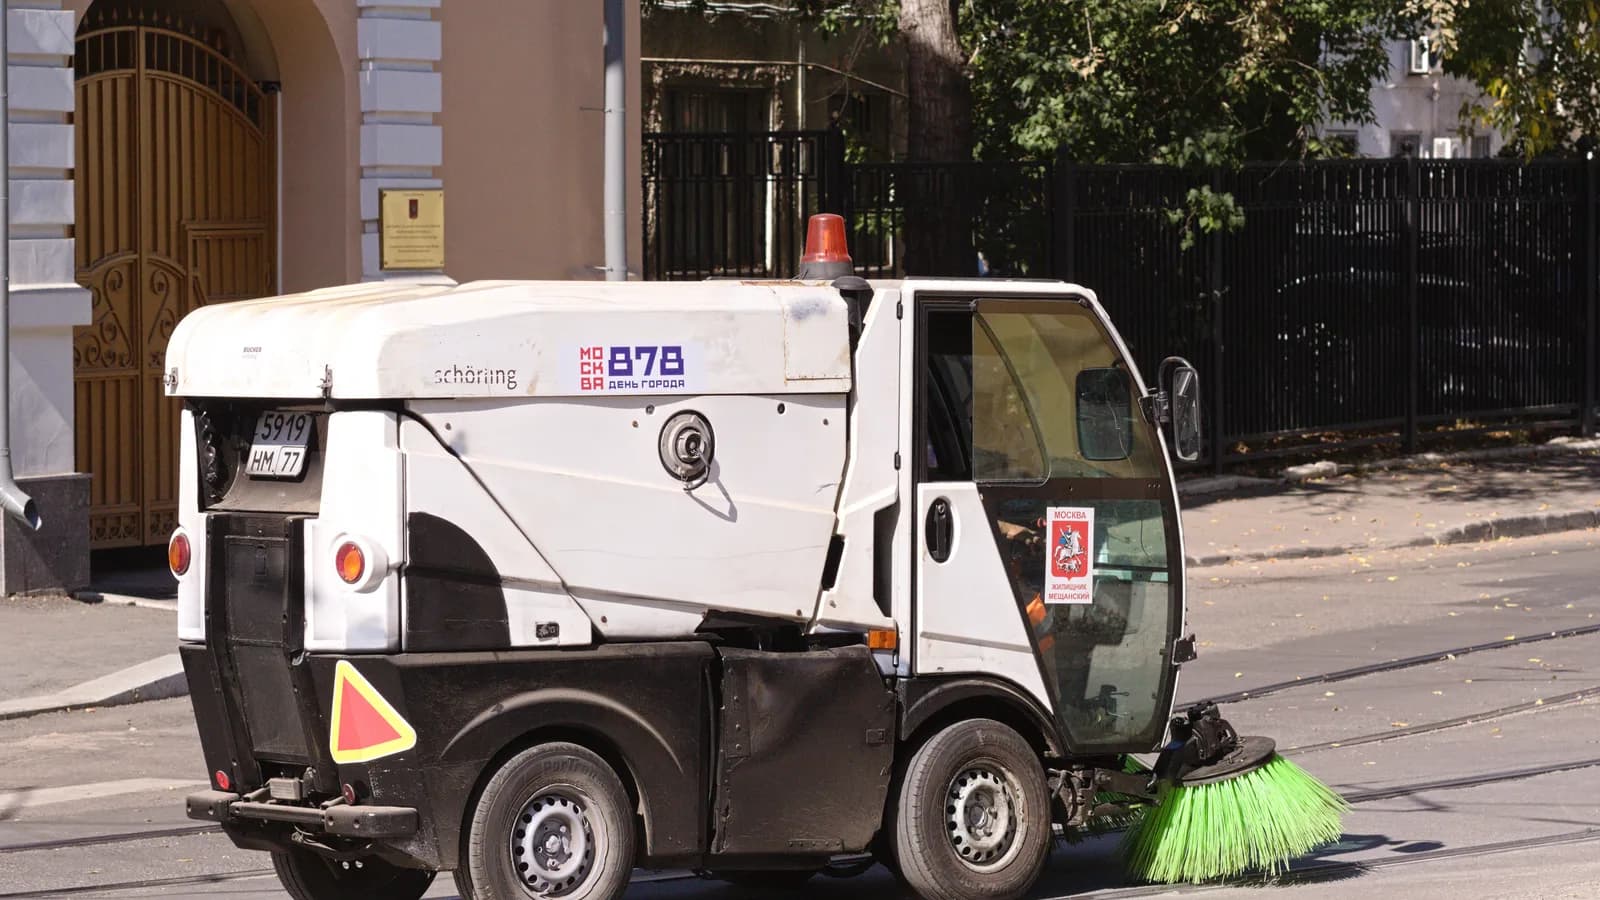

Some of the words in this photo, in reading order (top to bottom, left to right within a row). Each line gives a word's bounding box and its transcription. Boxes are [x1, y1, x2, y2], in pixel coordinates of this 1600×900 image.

[608, 345, 684, 376] 878
[608, 380, 638, 390] ДЕНЬ
[641, 379, 685, 389] ГОРОДА
[261, 413, 306, 441] 5919
[281, 451, 301, 473] 77
[1054, 511, 1087, 520] МОСКВА
[1051, 583, 1088, 591] ЖИЛИЩНИК
[1048, 591, 1090, 600] МЕЩАНСКИЙ
